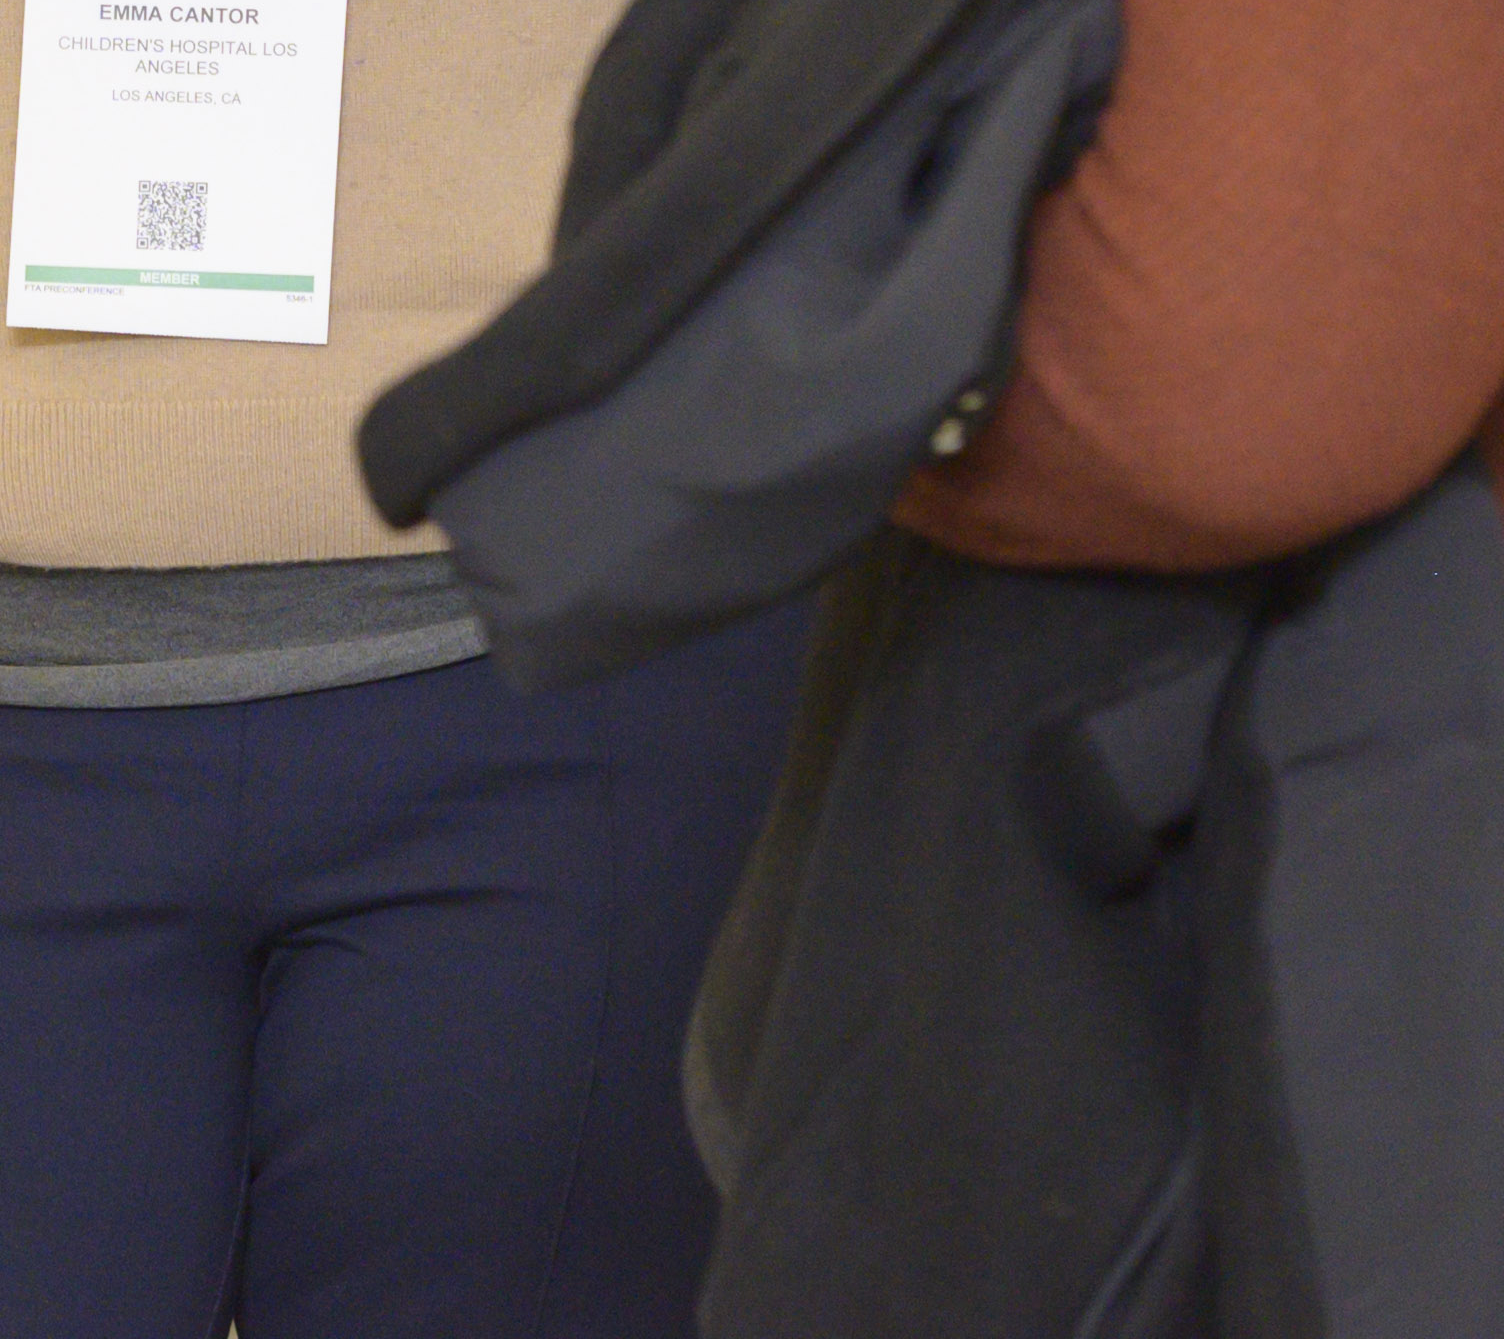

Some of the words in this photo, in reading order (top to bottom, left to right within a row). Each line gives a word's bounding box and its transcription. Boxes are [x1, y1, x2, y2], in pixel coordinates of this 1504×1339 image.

[99, 4, 163, 22] EMMA
[169, 6, 259, 25] CANTOR
[58, 35, 164, 53] CHILDREN'S
[170, 39, 257, 56] HOSPITAL
[263, 42, 298, 57] LOS
[135, 59, 220, 75] ANGELES
[111, 89, 140, 102] LOS
[145, 90, 217, 105] ANGELES,
[221, 92, 242, 105] CA
[139, 271, 200, 286] MEMBER
[43, 285, 125, 296] PRECONFERENCE
